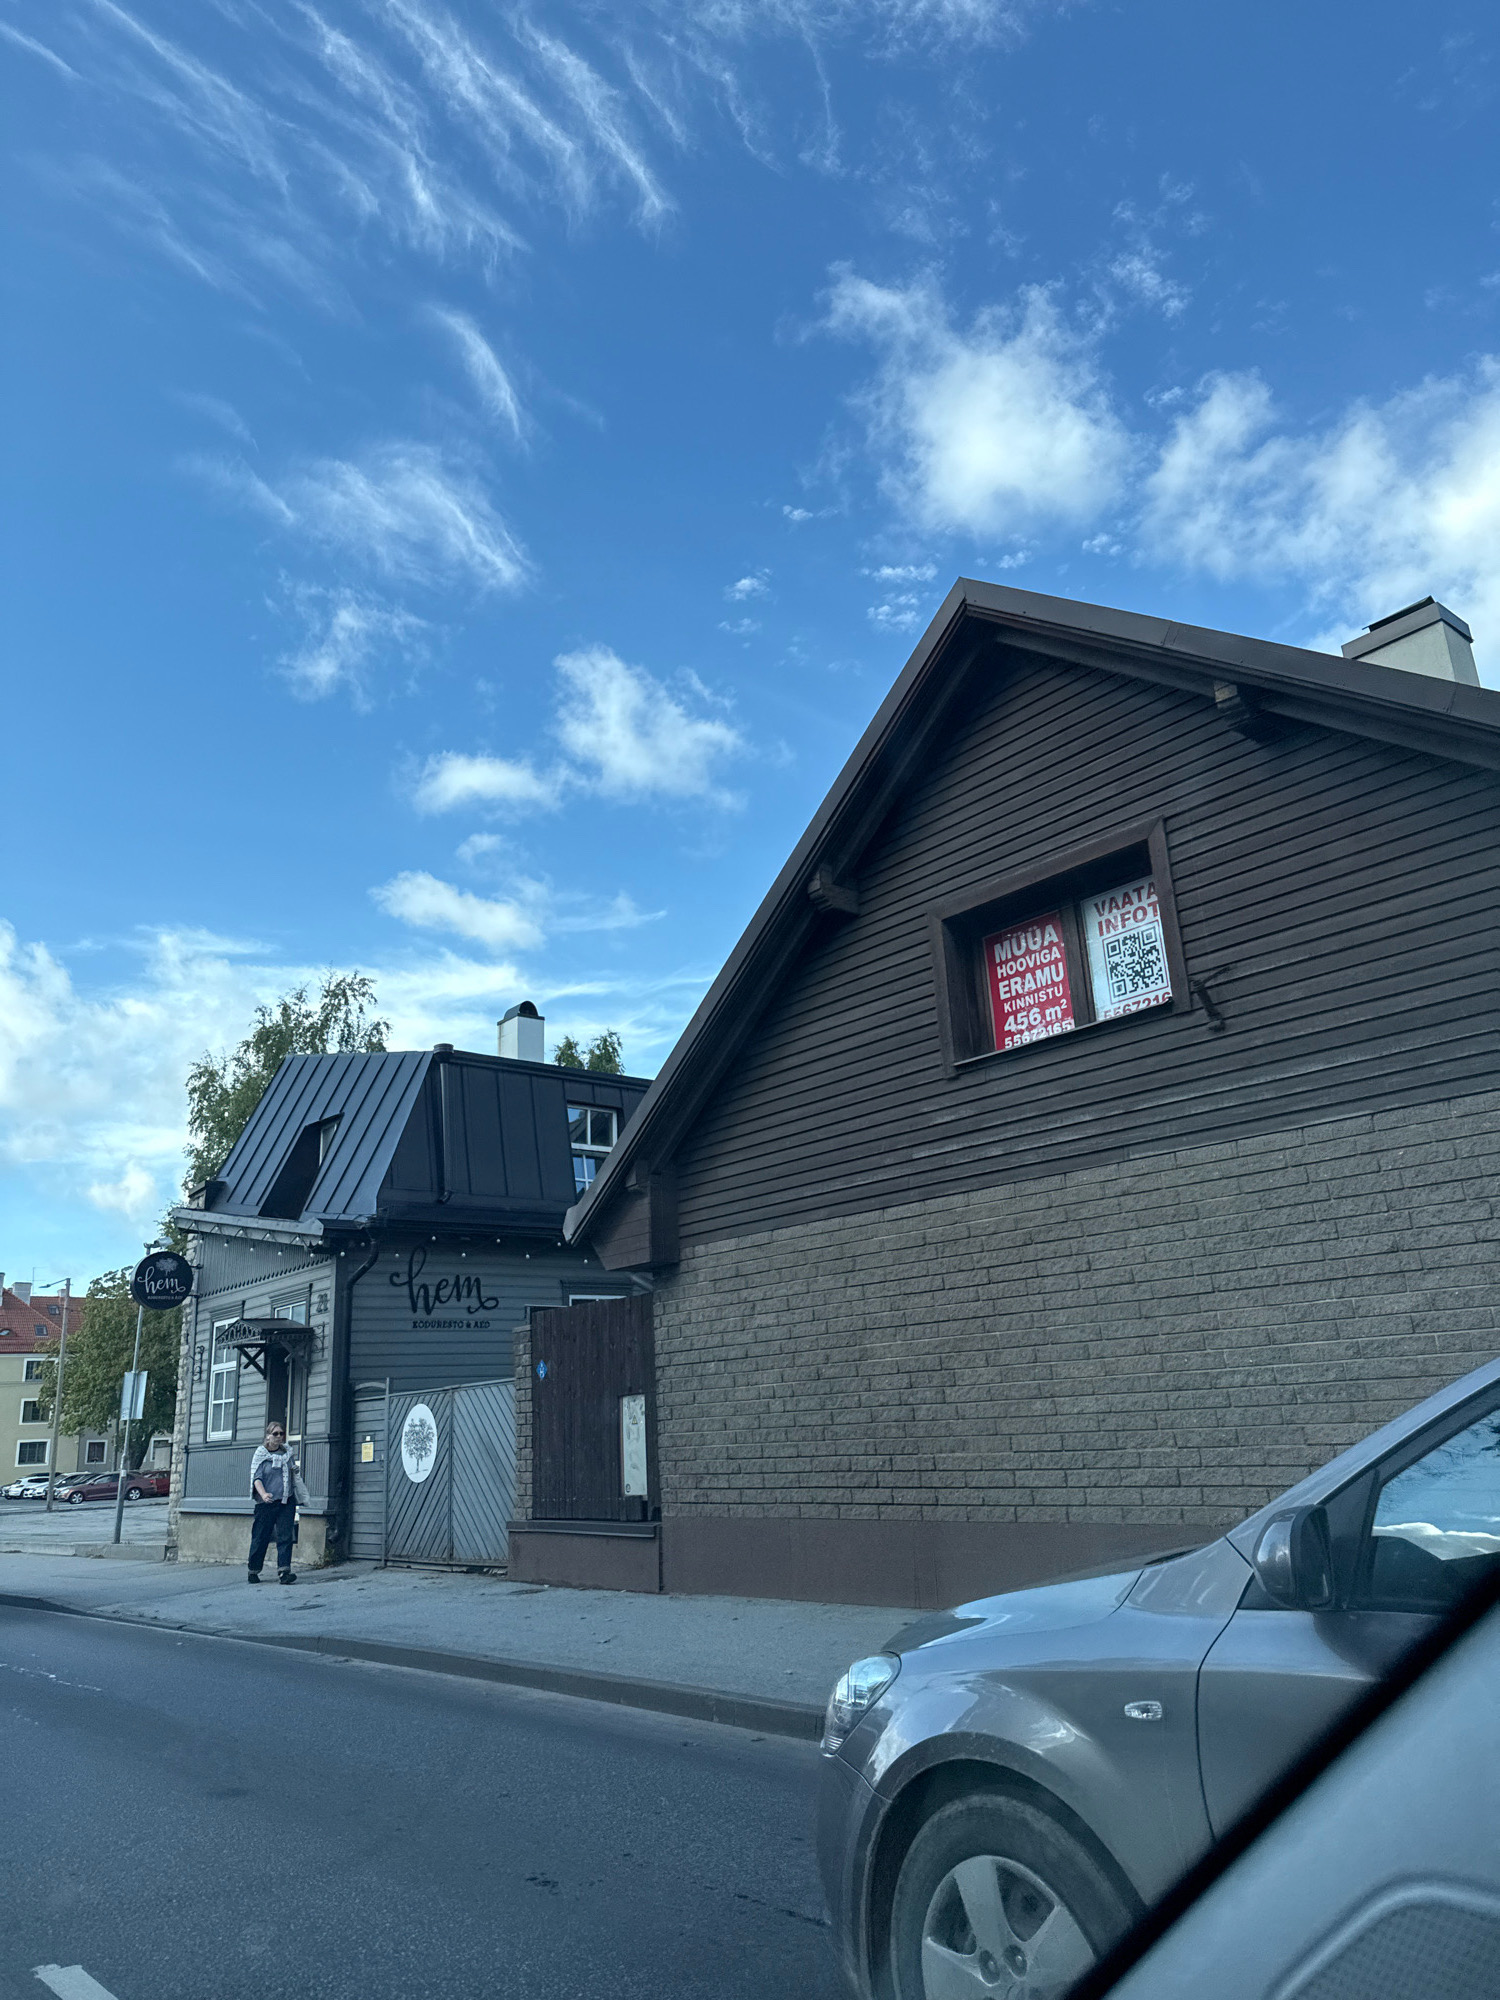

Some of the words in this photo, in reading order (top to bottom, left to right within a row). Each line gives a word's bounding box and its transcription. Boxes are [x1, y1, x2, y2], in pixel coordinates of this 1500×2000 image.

[1093, 881, 1158, 917] VAATA
[1098, 900, 1159, 937] INFOT
[993, 924, 1059, 964] MÜÜA
[996, 946, 1061, 979] HOOVIGA
[999, 961, 1065, 1001] ERAMU
[1003, 982, 1063, 1014] KINNISTU
[1004, 1006, 1042, 1033] 456
[1004, 1019, 1072, 1050] 55672165
[137, 1265, 187, 1295] hem
[389, 1245, 500, 1316] hem
[412, 1319, 464, 1329] KODURESTO
